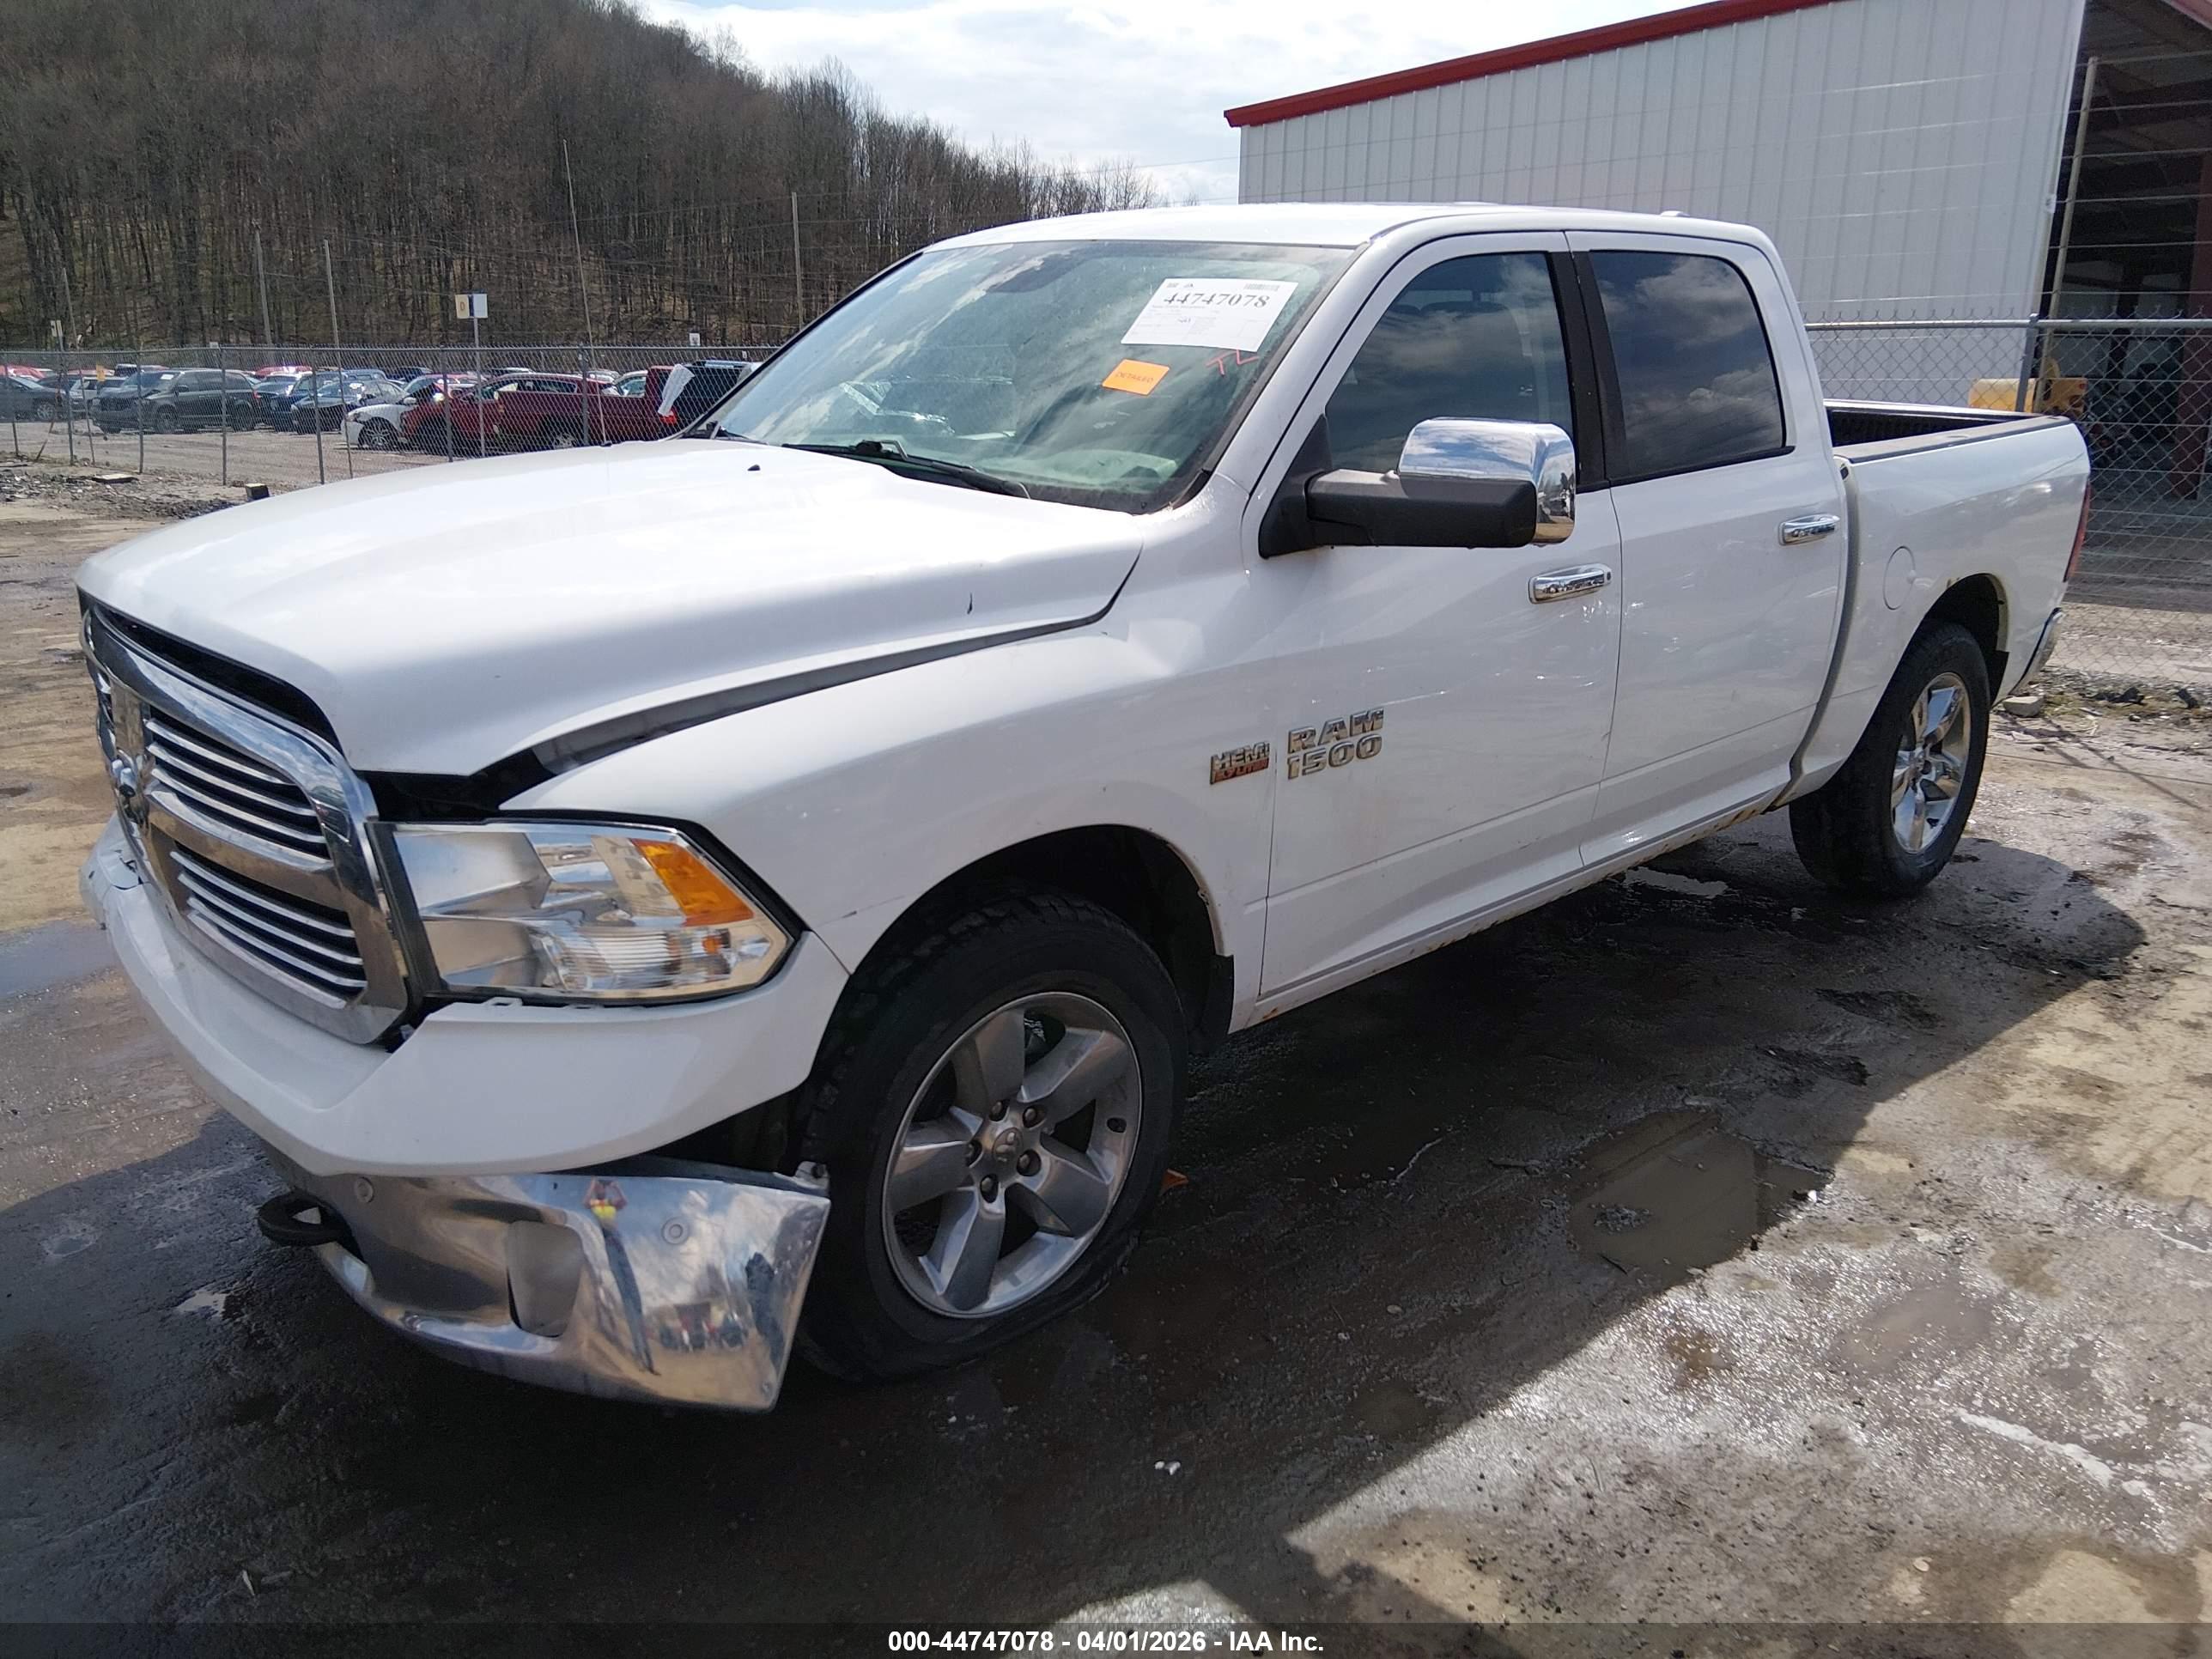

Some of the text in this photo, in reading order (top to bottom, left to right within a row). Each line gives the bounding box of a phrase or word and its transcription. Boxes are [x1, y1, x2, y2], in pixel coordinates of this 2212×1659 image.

[1164, 293, 1271, 308] 44747078
[1288, 708, 1384, 754] RAM
[1209, 742, 1270, 771] HEMI
[1287, 733, 1383, 780] 1500
